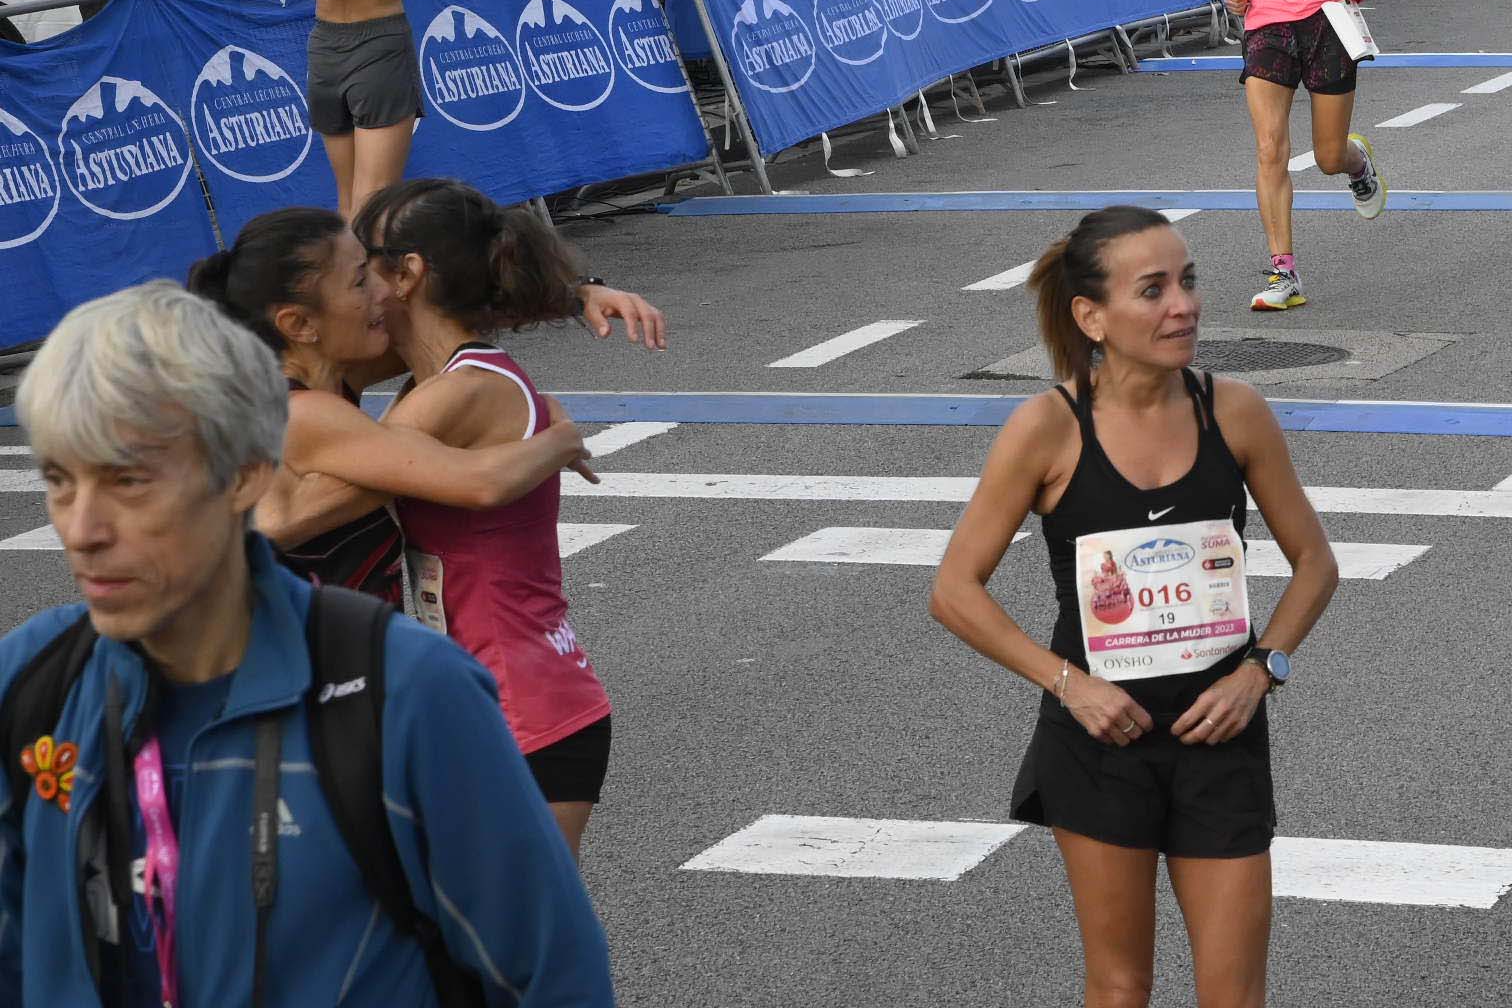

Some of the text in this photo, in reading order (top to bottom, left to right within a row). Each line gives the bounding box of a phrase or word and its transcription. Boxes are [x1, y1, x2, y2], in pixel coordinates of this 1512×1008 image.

[525, 41, 610, 86] ASTURIANA
[429, 56, 521, 105] ASTURIANA
[214, 90, 255, 112] CENTRAL
[203, 102, 308, 156] ASTURIANA
[71, 132, 185, 192] ASTURIANA
[1201, 538, 1231, 550] SUMA
[1130, 550, 1191, 568] ASTURIANA
[1138, 582, 1193, 608] 016
[1158, 612, 1175, 625] 19
[1105, 622, 1235, 647] CARRERA DE LA MUJER 2023
[1104, 654, 1153, 670] OYSHO
